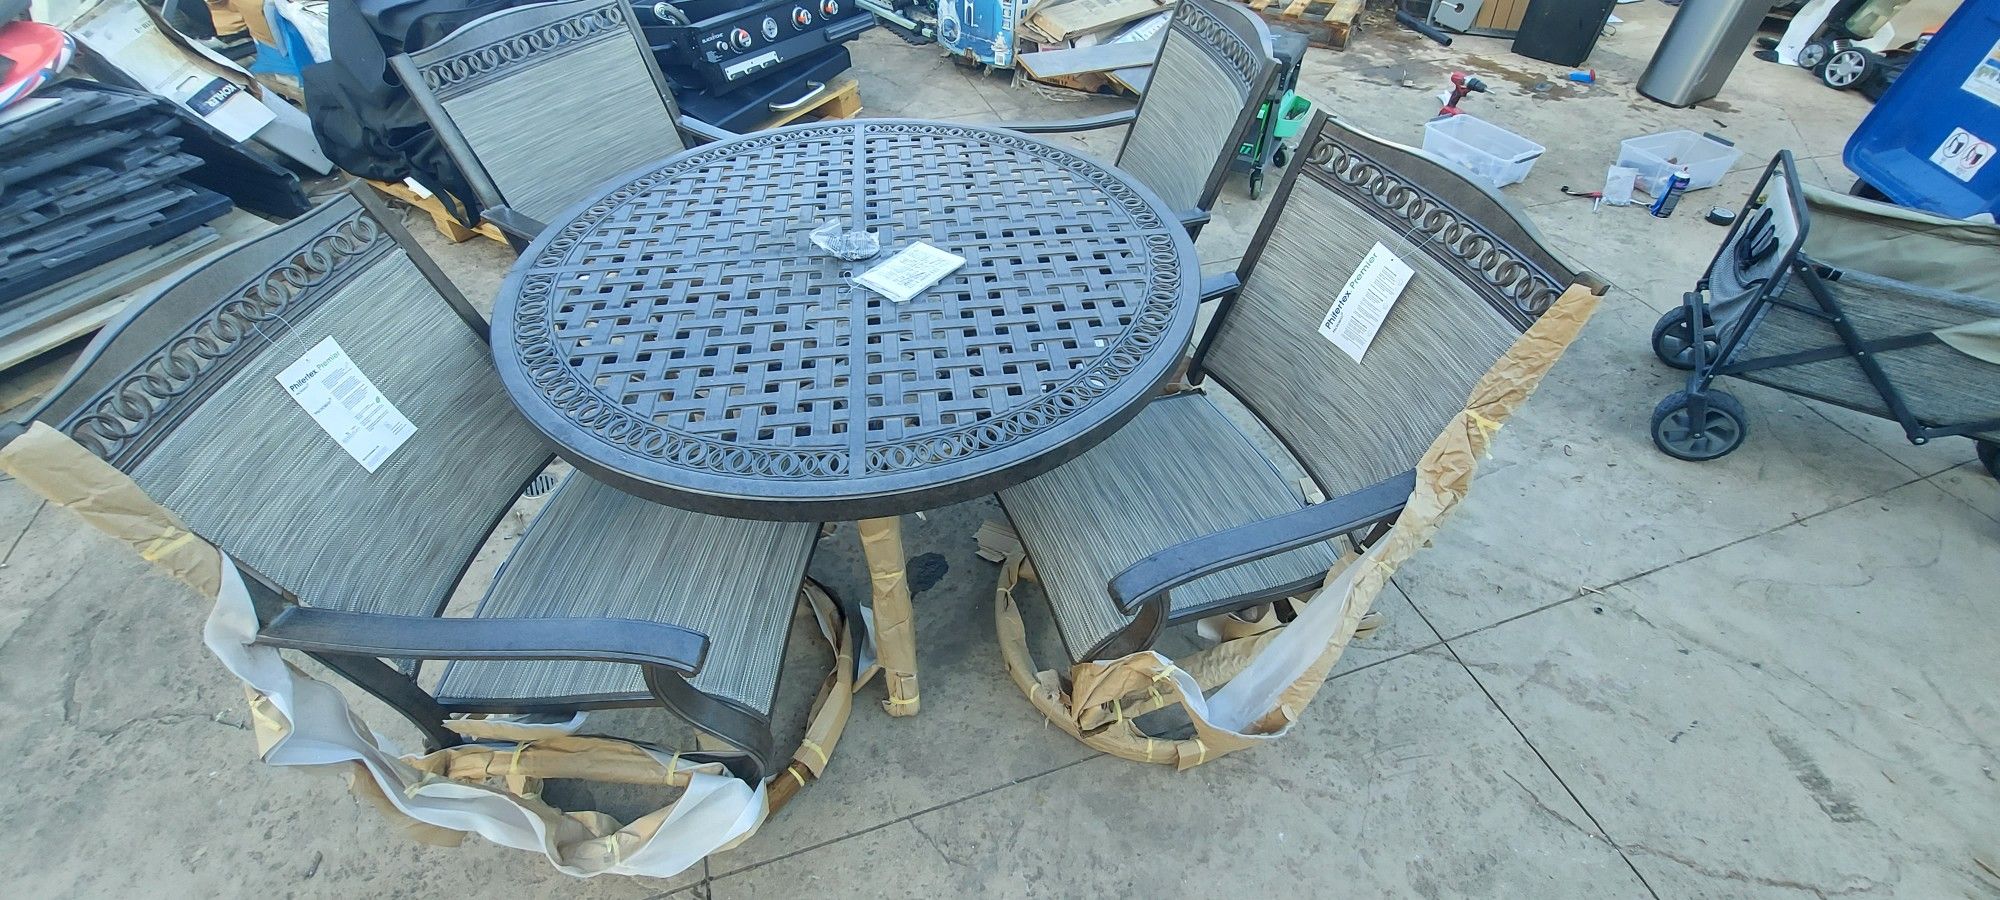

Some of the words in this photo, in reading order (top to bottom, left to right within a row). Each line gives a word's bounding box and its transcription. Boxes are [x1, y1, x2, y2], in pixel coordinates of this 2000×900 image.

[205, 83, 240, 107] KOHLER
[1325, 290, 1352, 329] Phifertex
[1350, 252, 1378, 289] Premier
[289, 369, 318, 392] Phifertex
[316, 351, 340, 371] Premier
